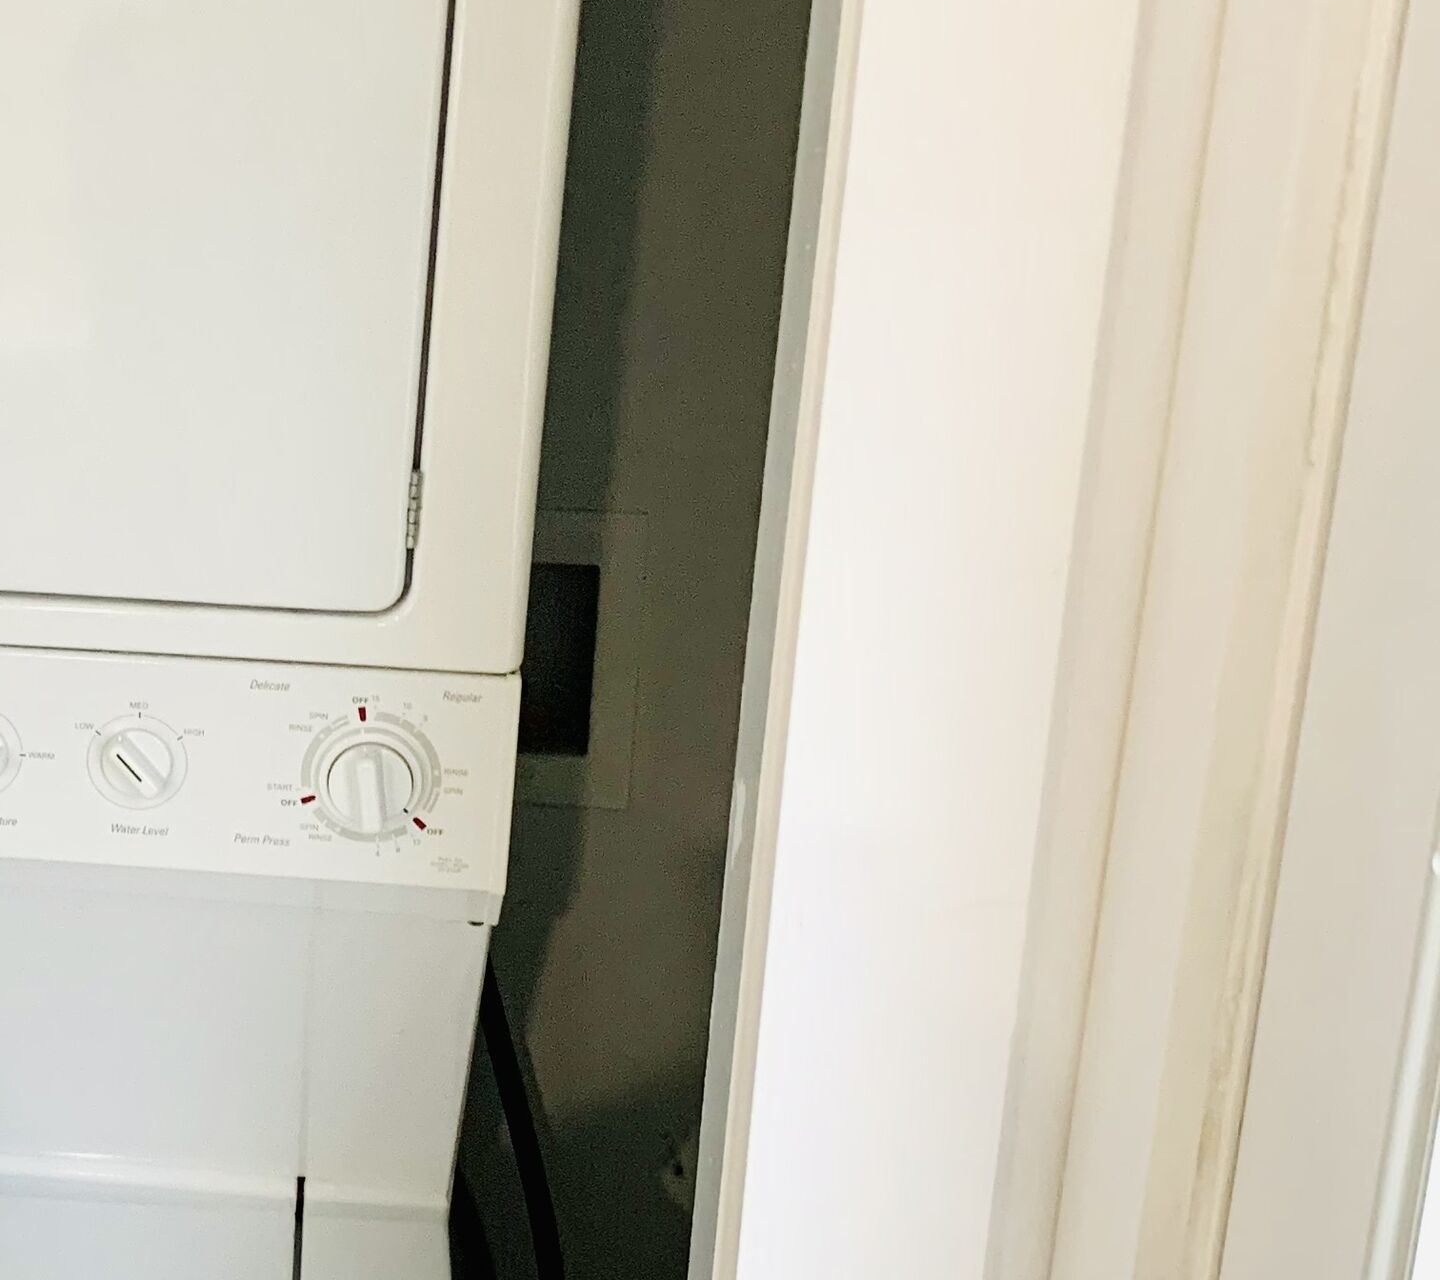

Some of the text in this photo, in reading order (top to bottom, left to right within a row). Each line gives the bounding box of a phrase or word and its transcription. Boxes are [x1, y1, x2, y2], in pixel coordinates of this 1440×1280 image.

[250, 679, 291, 692] Delicate
[352, 696, 368, 704] OFF
[443, 690, 483, 704] Regular
[129, 701, 149, 709] MED
[309, 712, 329, 721] SPIN
[74, 722, 95, 730] LOW
[183, 728, 206, 737] HIGH
[28, 751, 56, 760] WARM
[267, 783, 293, 792] START
[280, 799, 297, 807] OFF
[111, 823, 170, 836] Water Level
[427, 828, 444, 836] OFF
[234, 832, 291, 847] Perm Press
